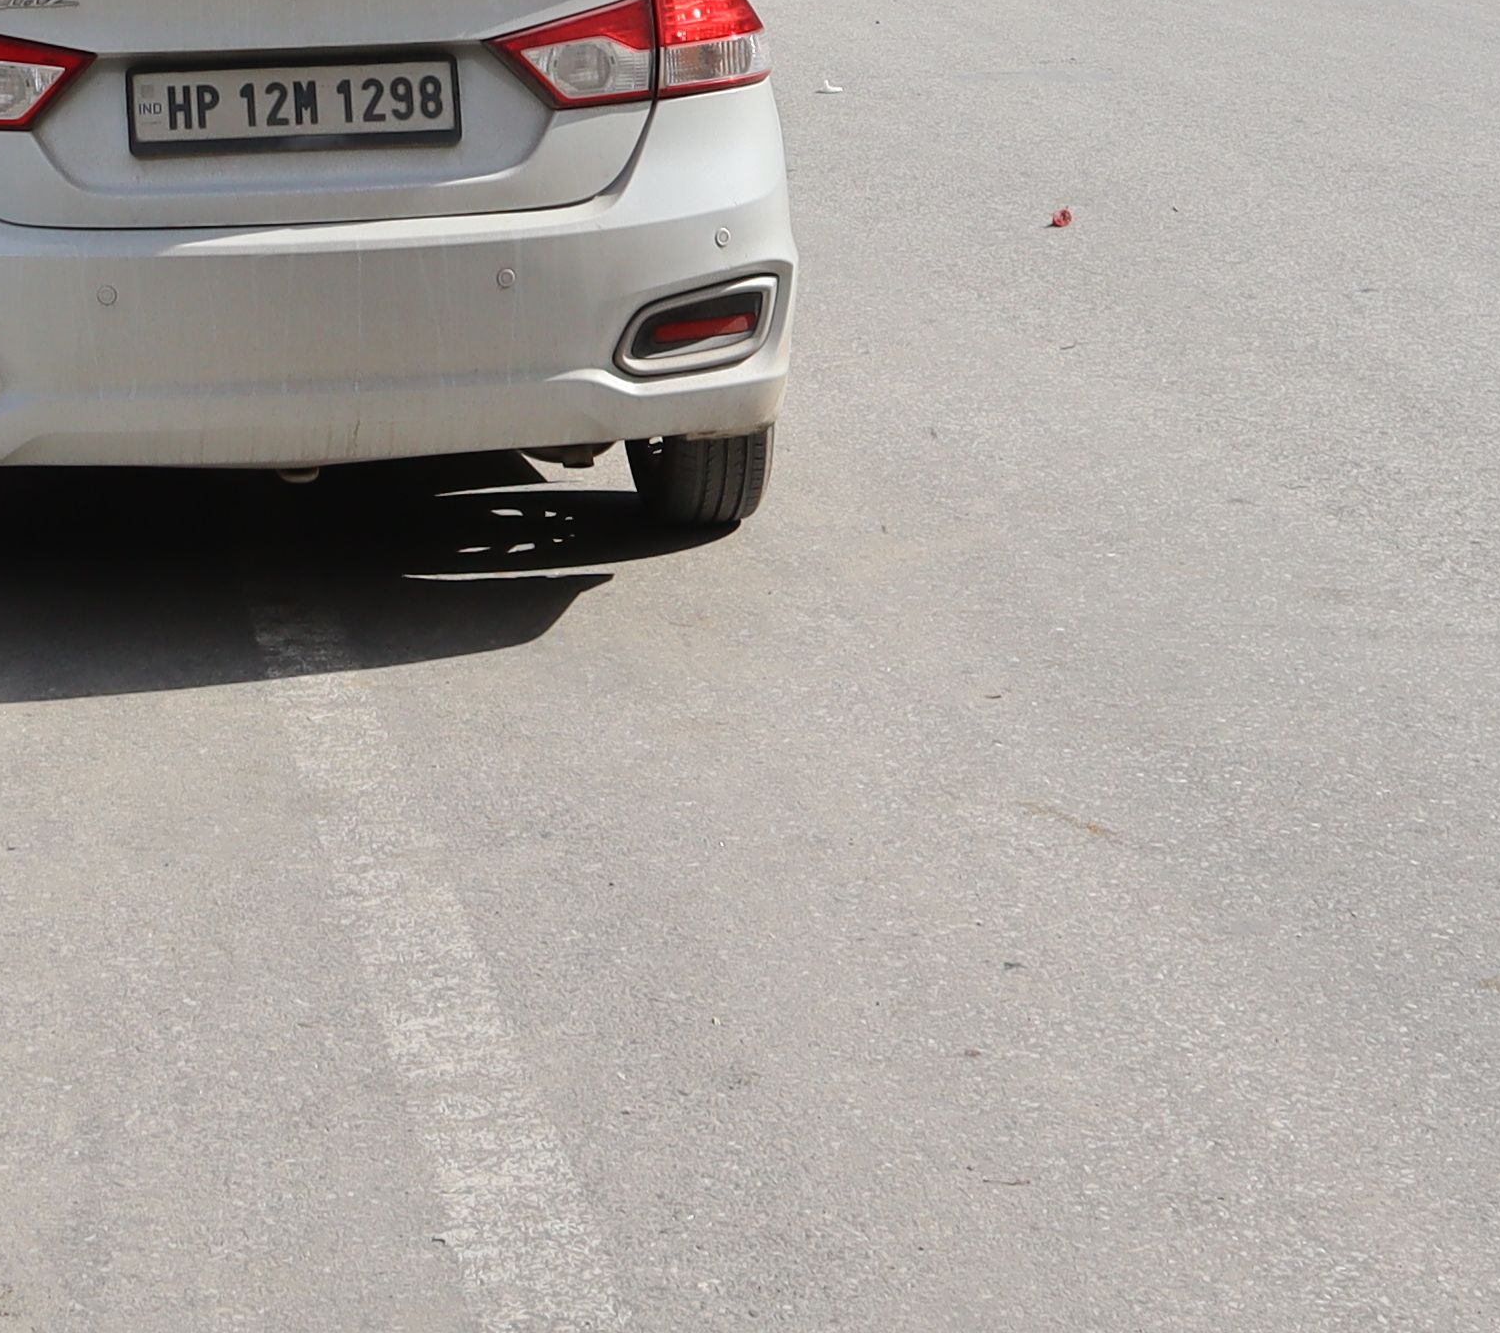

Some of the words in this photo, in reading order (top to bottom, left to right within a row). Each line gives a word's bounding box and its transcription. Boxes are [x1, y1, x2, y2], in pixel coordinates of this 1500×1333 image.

[138, 102, 162, 116] IND
[166, 84, 220, 130] HP
[239, 80, 319, 127] 12M
[336, 75, 444, 124] 1298
